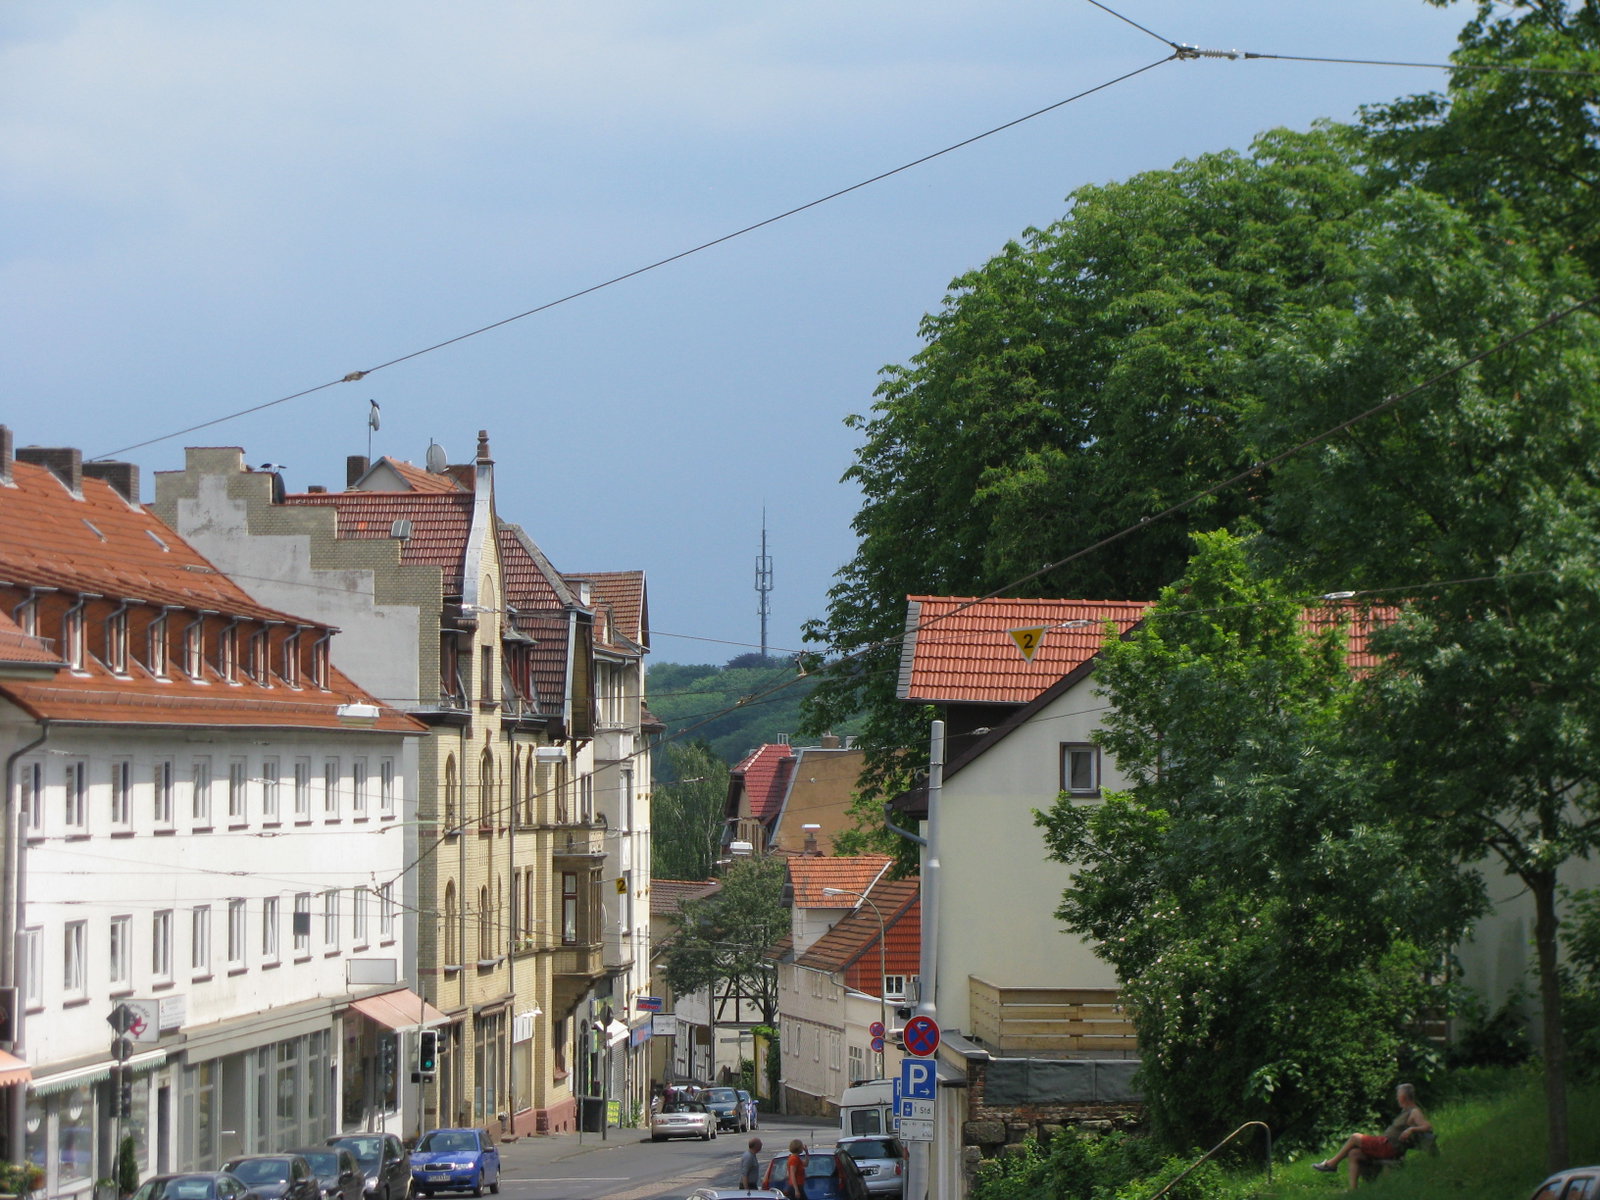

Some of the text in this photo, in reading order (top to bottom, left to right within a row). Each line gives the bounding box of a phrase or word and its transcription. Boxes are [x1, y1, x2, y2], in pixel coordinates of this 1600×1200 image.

[1023, 633, 1034, 649] 2
[617, 879, 626, 891] 2
[909, 1064, 928, 1095] P
